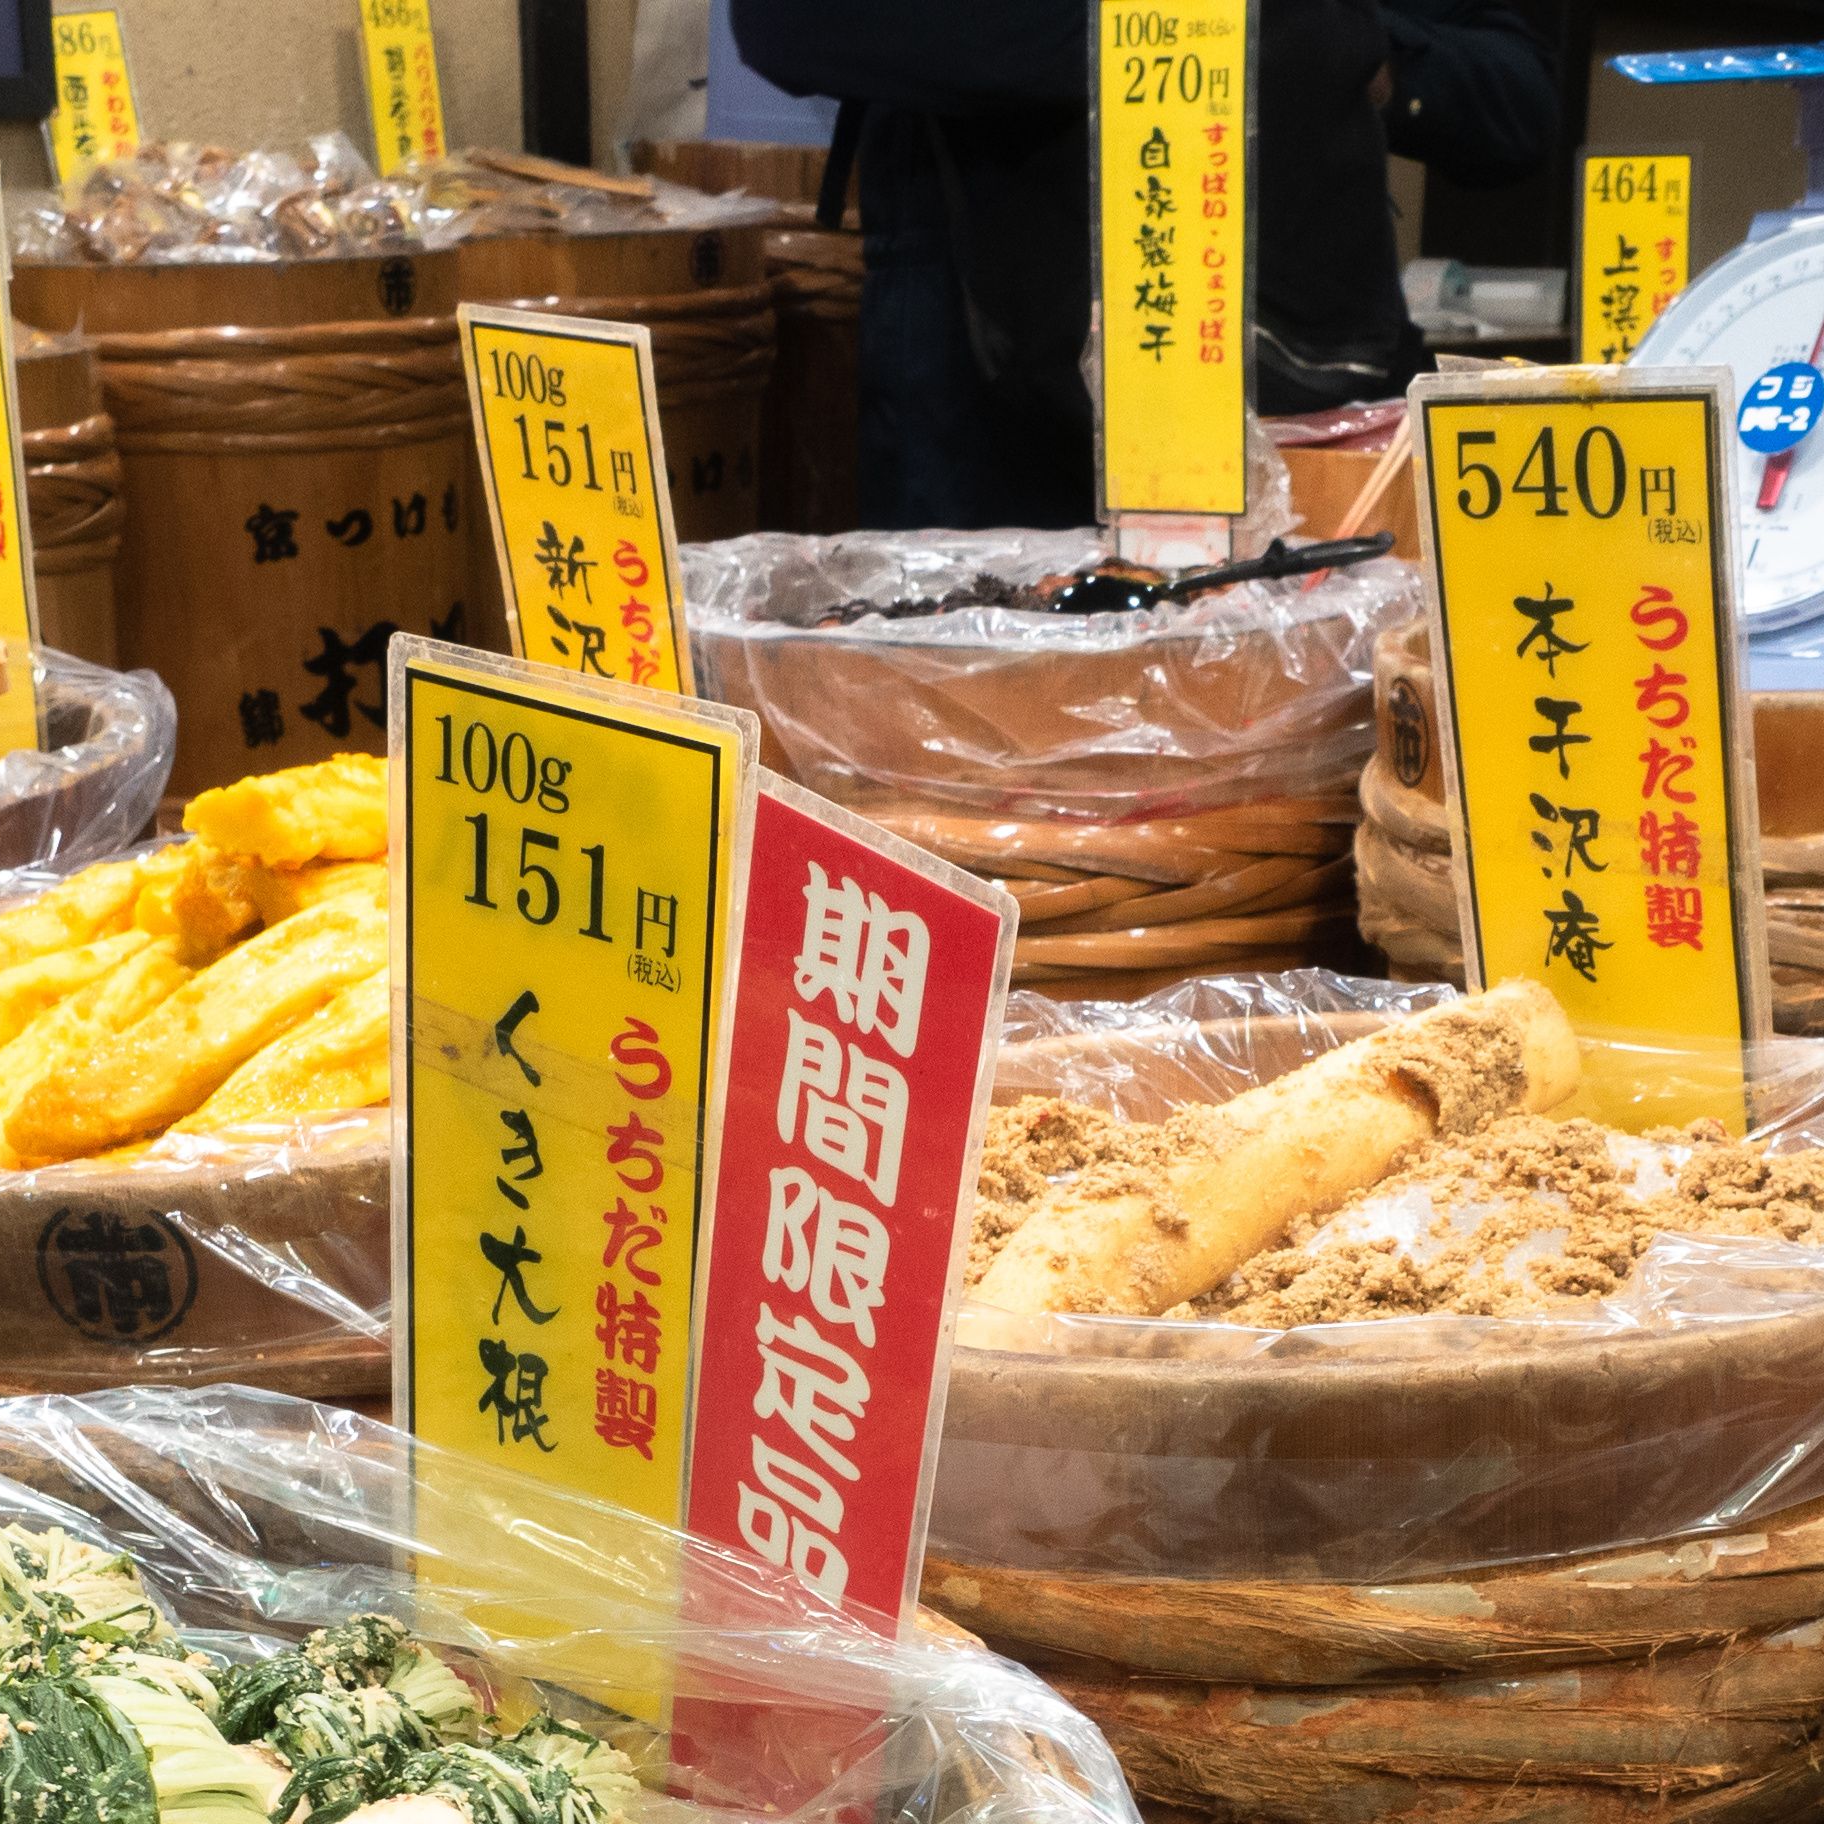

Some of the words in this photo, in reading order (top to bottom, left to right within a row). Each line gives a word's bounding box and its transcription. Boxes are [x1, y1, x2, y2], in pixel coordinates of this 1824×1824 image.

[1114, 10, 1179, 48] 100g
[1124, 53, 1230, 104] 270円
[1592, 162, 1682, 203] 464円
[1134, 126, 1178, 364] 自家製梅干
[489, 348, 567, 407] 100g
[513, 413, 638, 496] 151円
[1455, 425, 1678, 521] 540円
[1647, 517, 1703, 546] (税込)
[612, 538, 661, 688] うちだ
[433, 714, 572, 815] 100g
[1512, 582, 1614, 984] 本干沢庵
[1630, 586, 1704, 953] うちだ特製
[463, 812, 680, 961] 151円
[626, 953, 683, 995] (税込)
[478, 989, 562, 1455] くき大根
[595, 1015, 674, 1462] うちだ特製
[738, 859, 931, 1612] 期間限定品
